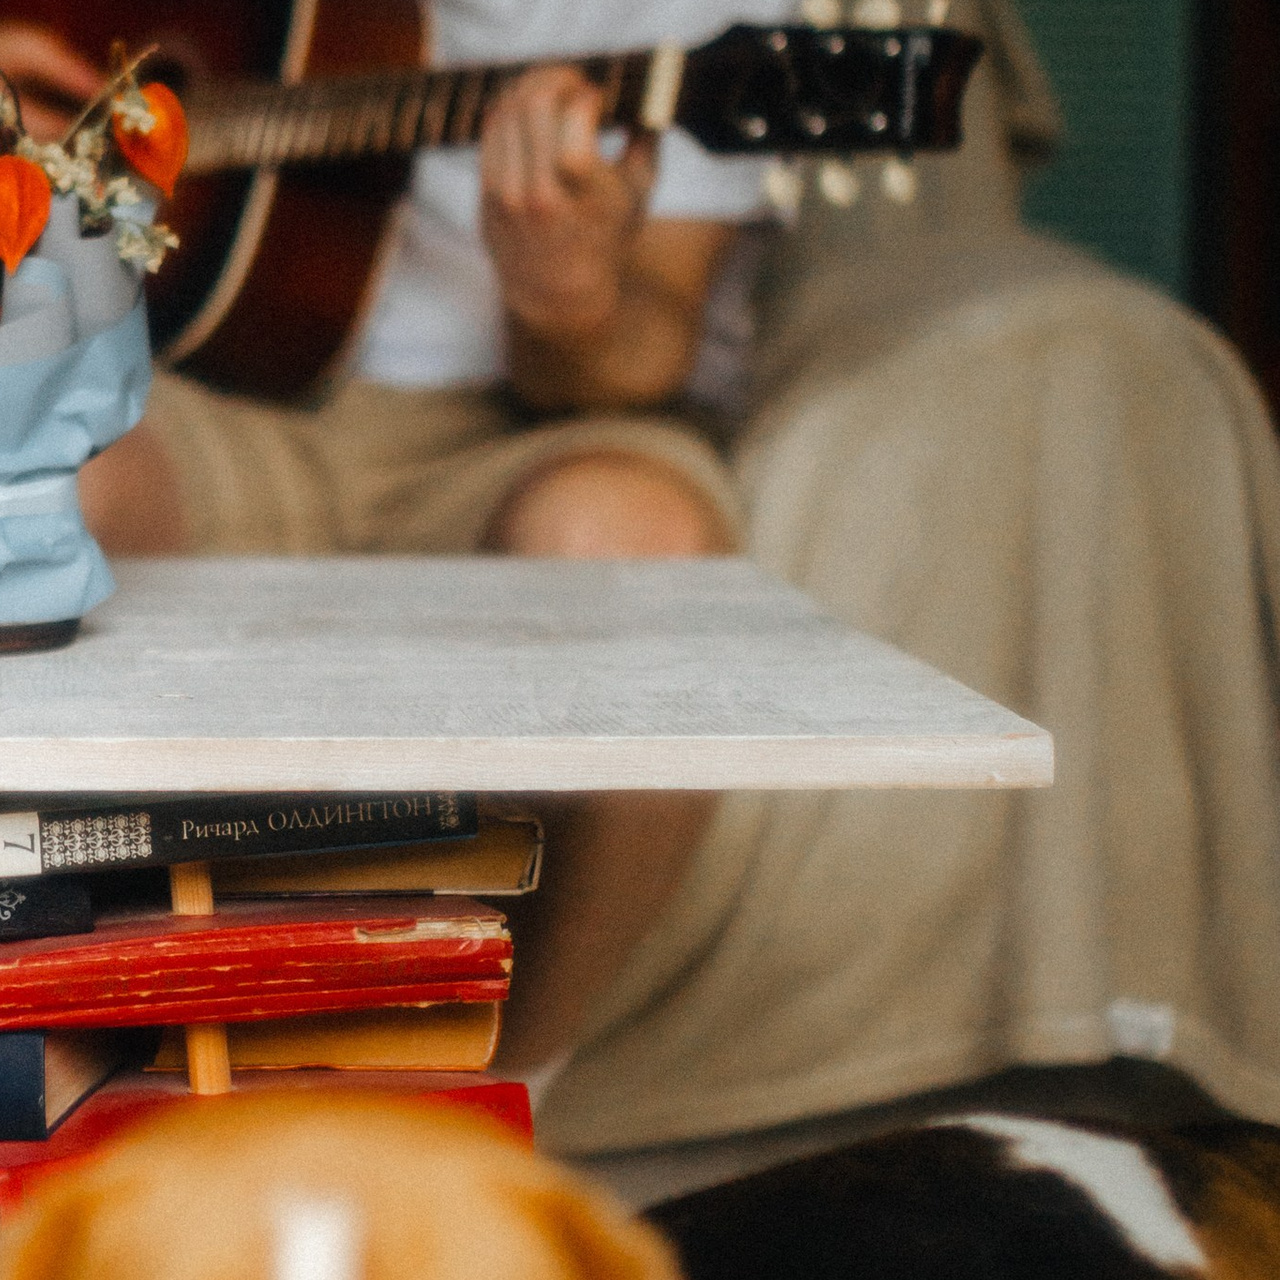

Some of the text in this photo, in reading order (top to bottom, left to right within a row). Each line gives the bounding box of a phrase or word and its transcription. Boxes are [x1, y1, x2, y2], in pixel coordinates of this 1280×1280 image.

[182, 796, 431, 841] Ричард ОЛДИНГТОН
[3, 833, 35, 854] 7
